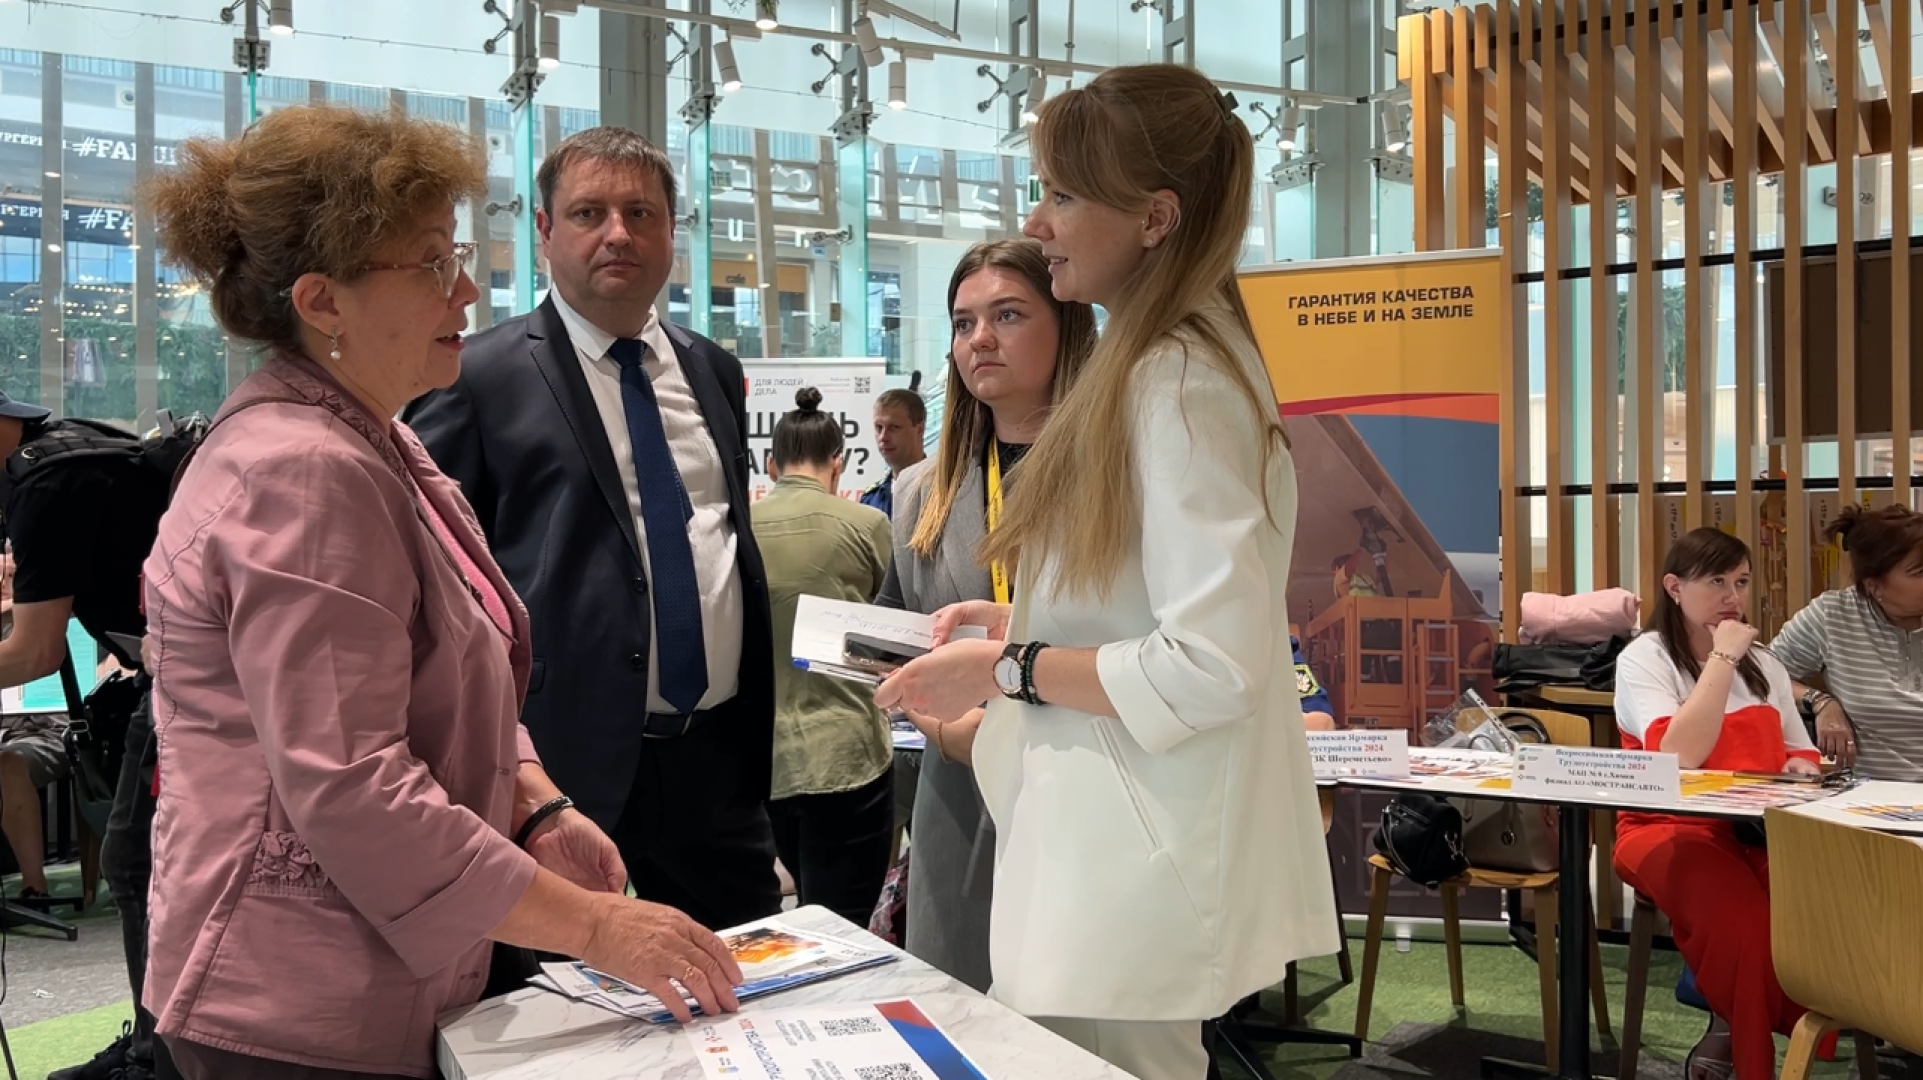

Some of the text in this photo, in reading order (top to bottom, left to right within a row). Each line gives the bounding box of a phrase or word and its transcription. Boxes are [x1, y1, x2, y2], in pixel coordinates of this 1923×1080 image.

[1288, 285, 1474, 309] ГАРАНТИЯ КАЧЕСТВА
[1297, 304, 1473, 326] В НЕБЕ И НА ЗЕМЛЕ
[774, 377, 804, 387] ЛЮДЕЙ
[1364, 744, 1384, 752] 2024
[1627, 762, 1647, 771] 2024
